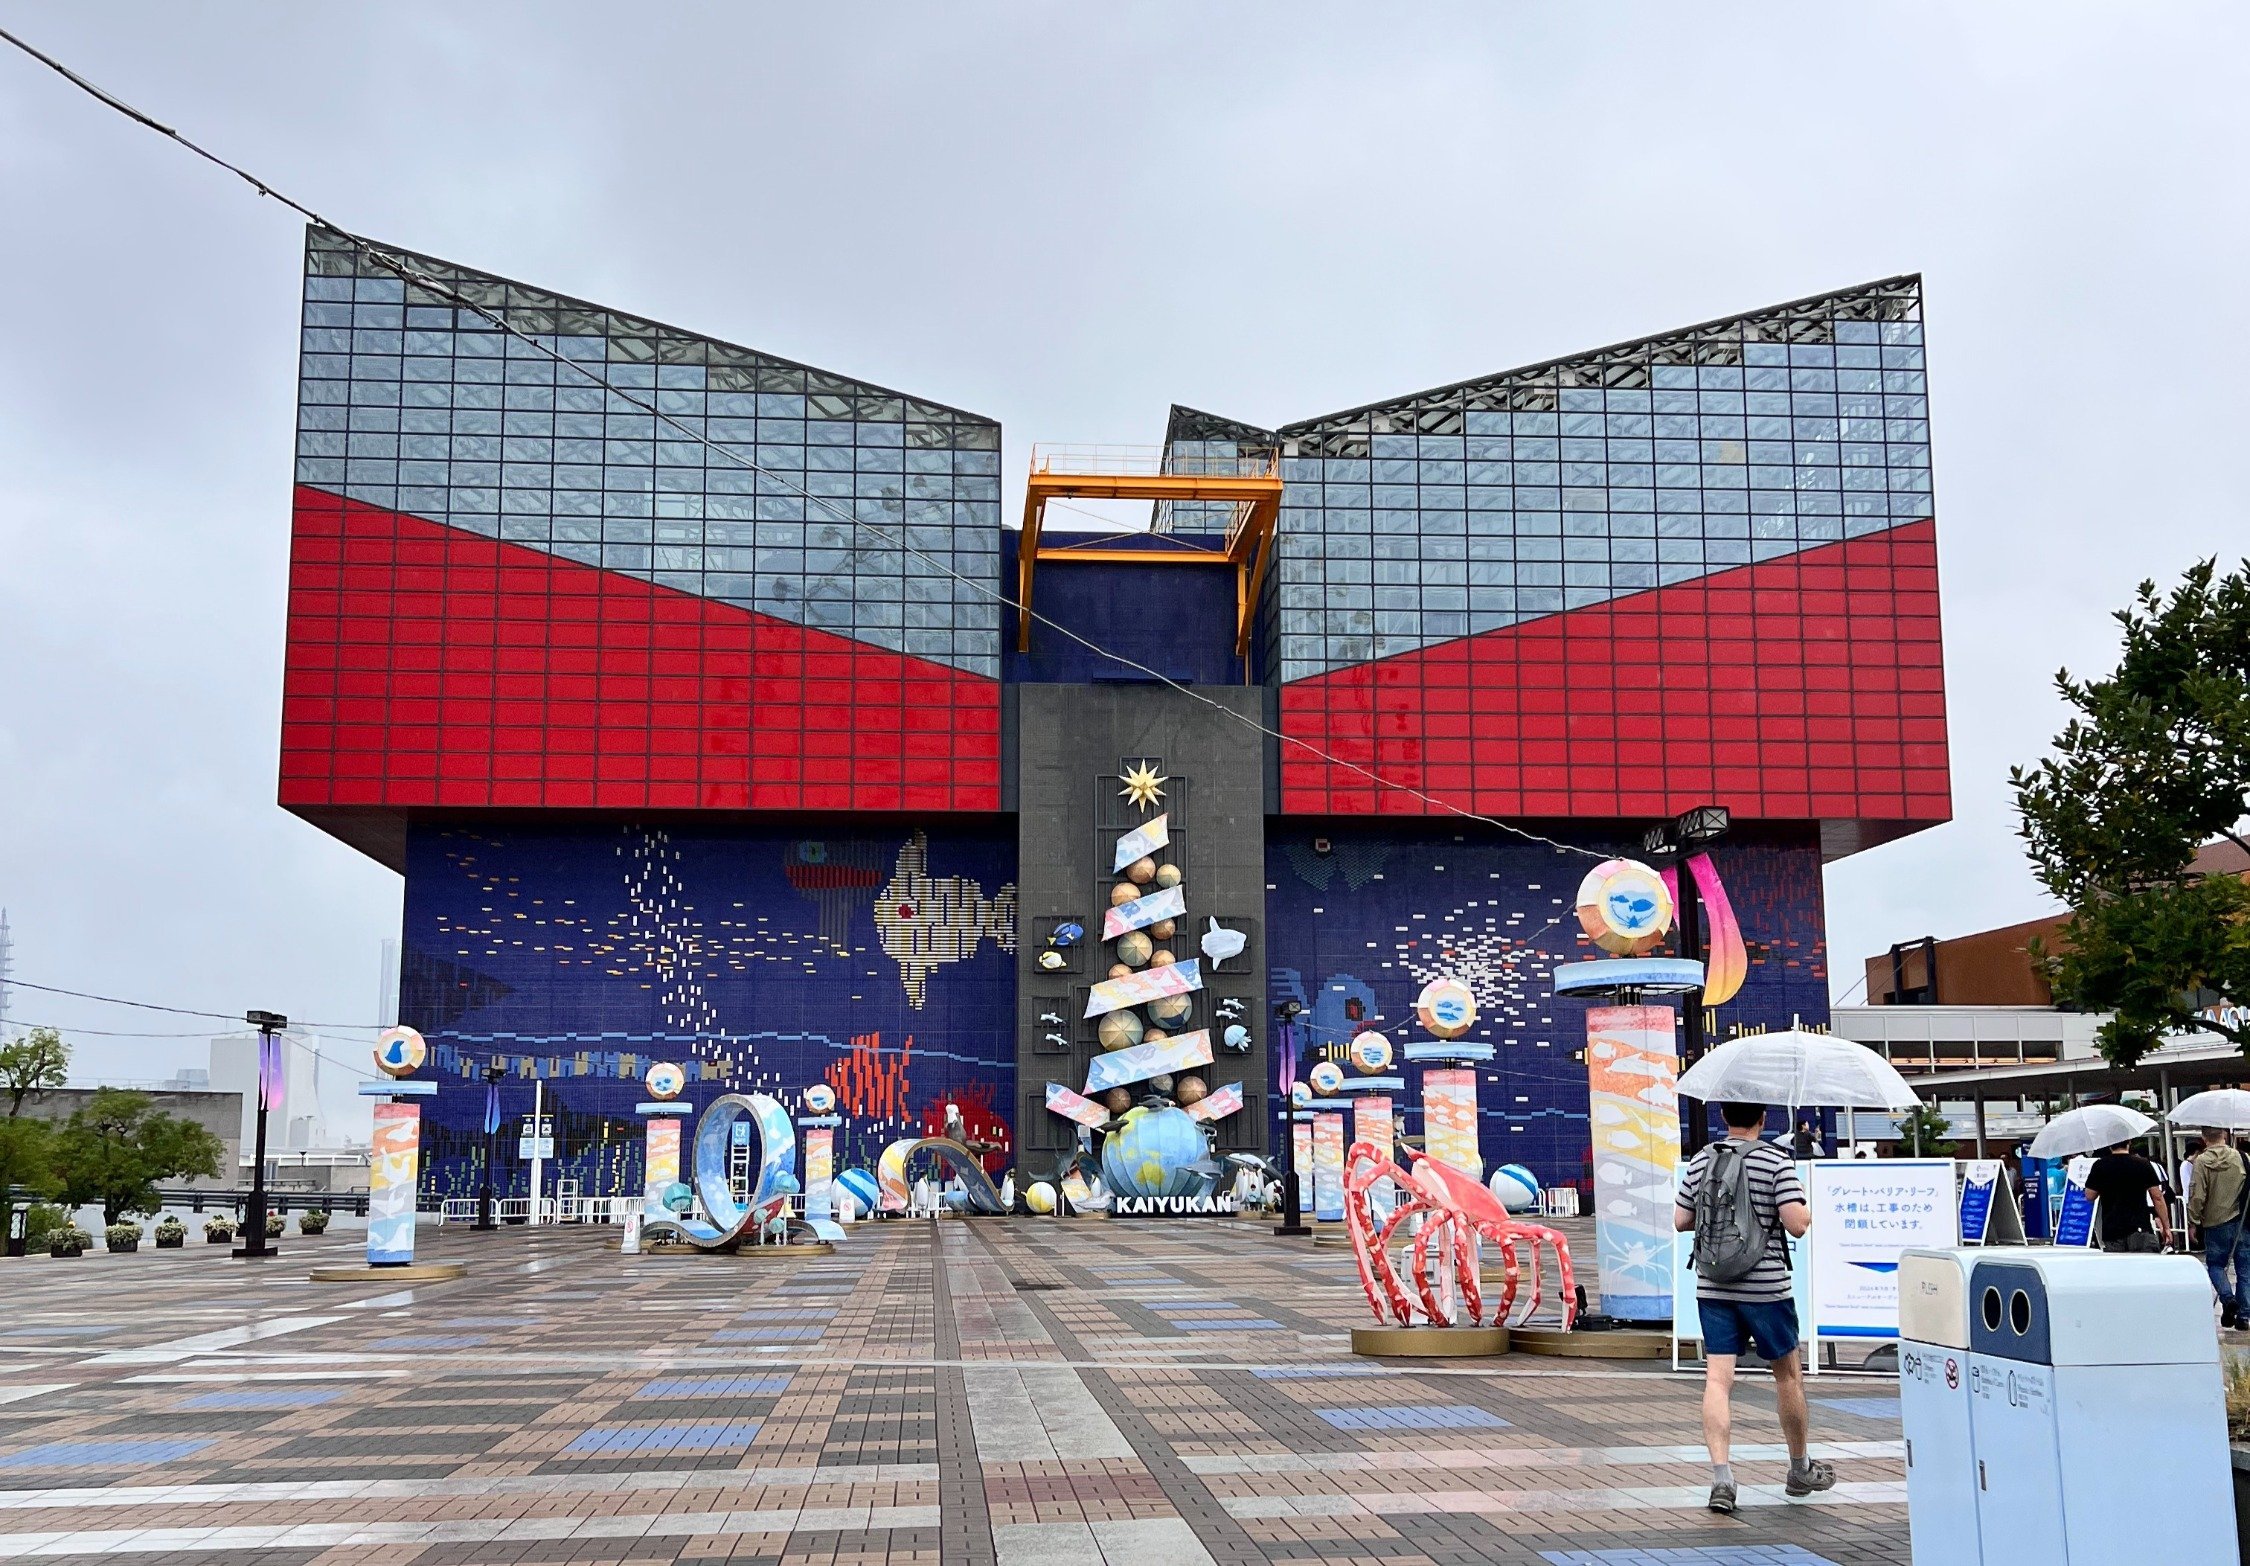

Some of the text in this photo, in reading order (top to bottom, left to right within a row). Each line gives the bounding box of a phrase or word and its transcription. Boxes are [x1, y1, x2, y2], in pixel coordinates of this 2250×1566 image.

[1117, 1196, 1231, 1213] KAIYUKAN
[1835, 1203, 1933, 1213] 水槽は、工事のため
[1844, 1219, 1922, 1230] 閉鎖しています。
